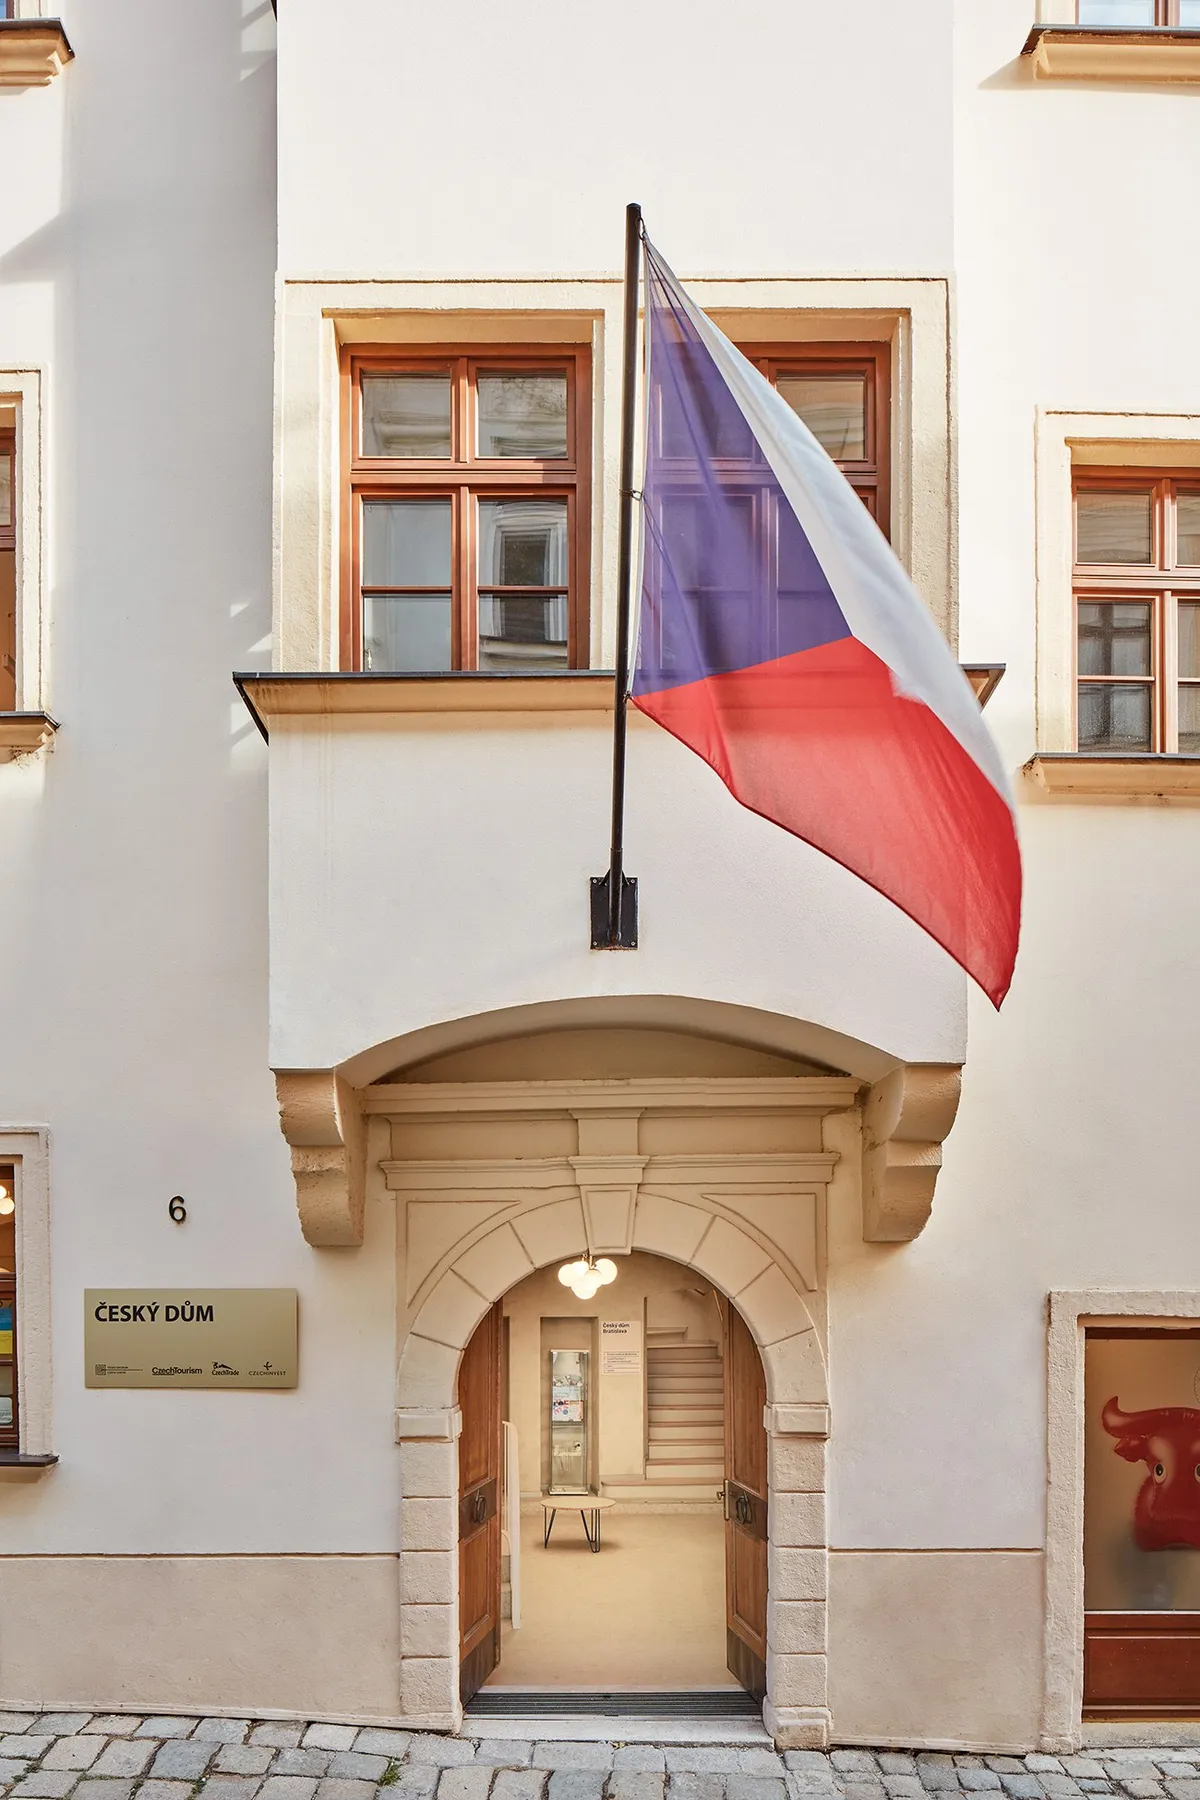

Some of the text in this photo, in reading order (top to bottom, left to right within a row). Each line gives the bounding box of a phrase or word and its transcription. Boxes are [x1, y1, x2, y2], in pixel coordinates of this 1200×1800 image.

[169, 1195, 187, 1222] 6
[95, 1300, 214, 1322] ČESKÝ DŮM
[152, 1366, 203, 1375] CzechTourism
